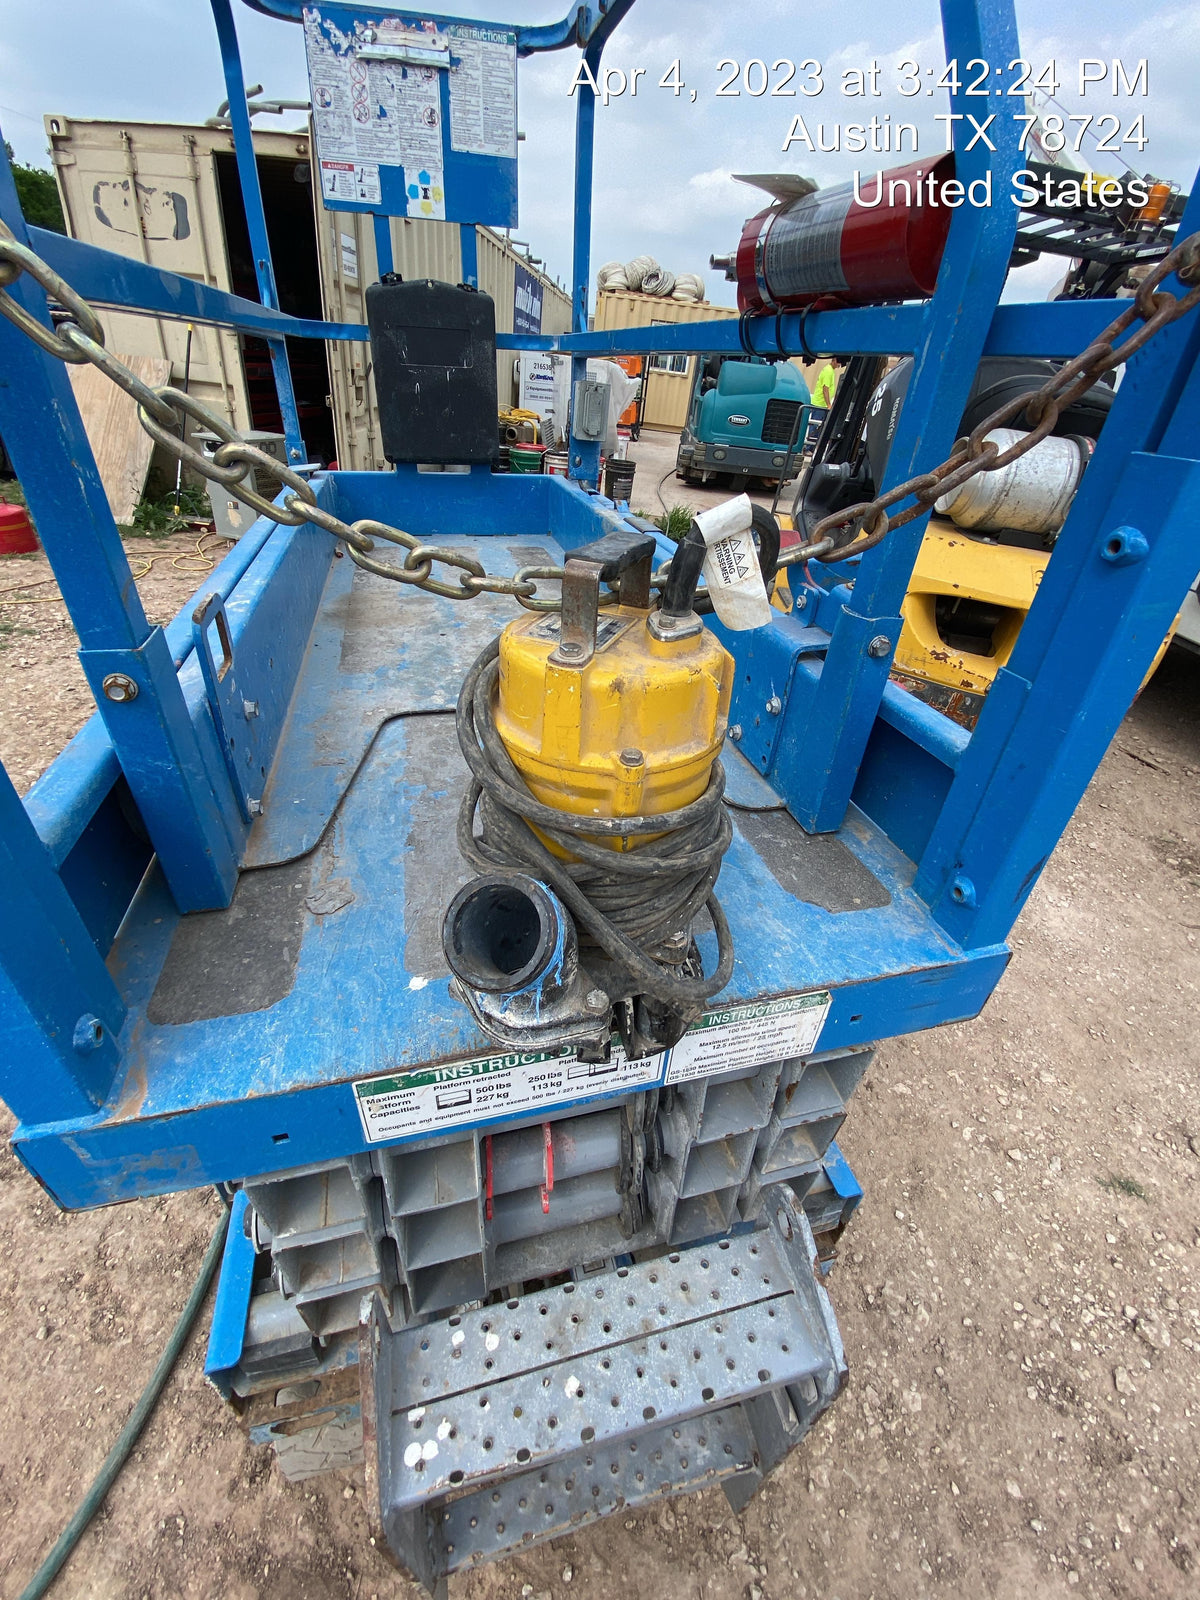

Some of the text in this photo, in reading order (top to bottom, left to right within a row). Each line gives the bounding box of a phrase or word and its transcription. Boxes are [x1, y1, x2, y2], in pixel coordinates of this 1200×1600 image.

[456, 27, 507, 44] INSTRUCTIONS
[872, 383, 887, 417] 25
[886, 397, 900, 441] KOMATSU
[713, 541, 731, 585] RTISSEMENT
[708, 999, 802, 1026] INSTRUCTIONS
[699, 1037, 730, 1047] Maximum
[434, 1045, 578, 1082] INSTRUCO
[693, 1052, 724, 1062] Maximum
[698, 1060, 728, 1069] Maximum
[433, 1058, 577, 1091] Platform retracted Platf
[697, 1065, 726, 1074] Maximum
[475, 1071, 563, 1094] 500 lbs 250 lbs
[476, 1060, 651, 1103] 227 kg 113 kg 113 kg
[366, 1091, 416, 1105] Maximum
[368, 1100, 411, 1112] Patform
[370, 1105, 421, 1119] Capacities
[378, 1121, 417, 1132] Occupants
[434, 1109, 471, 1121] equipment
[506, 1096, 530, 1106] exceed
